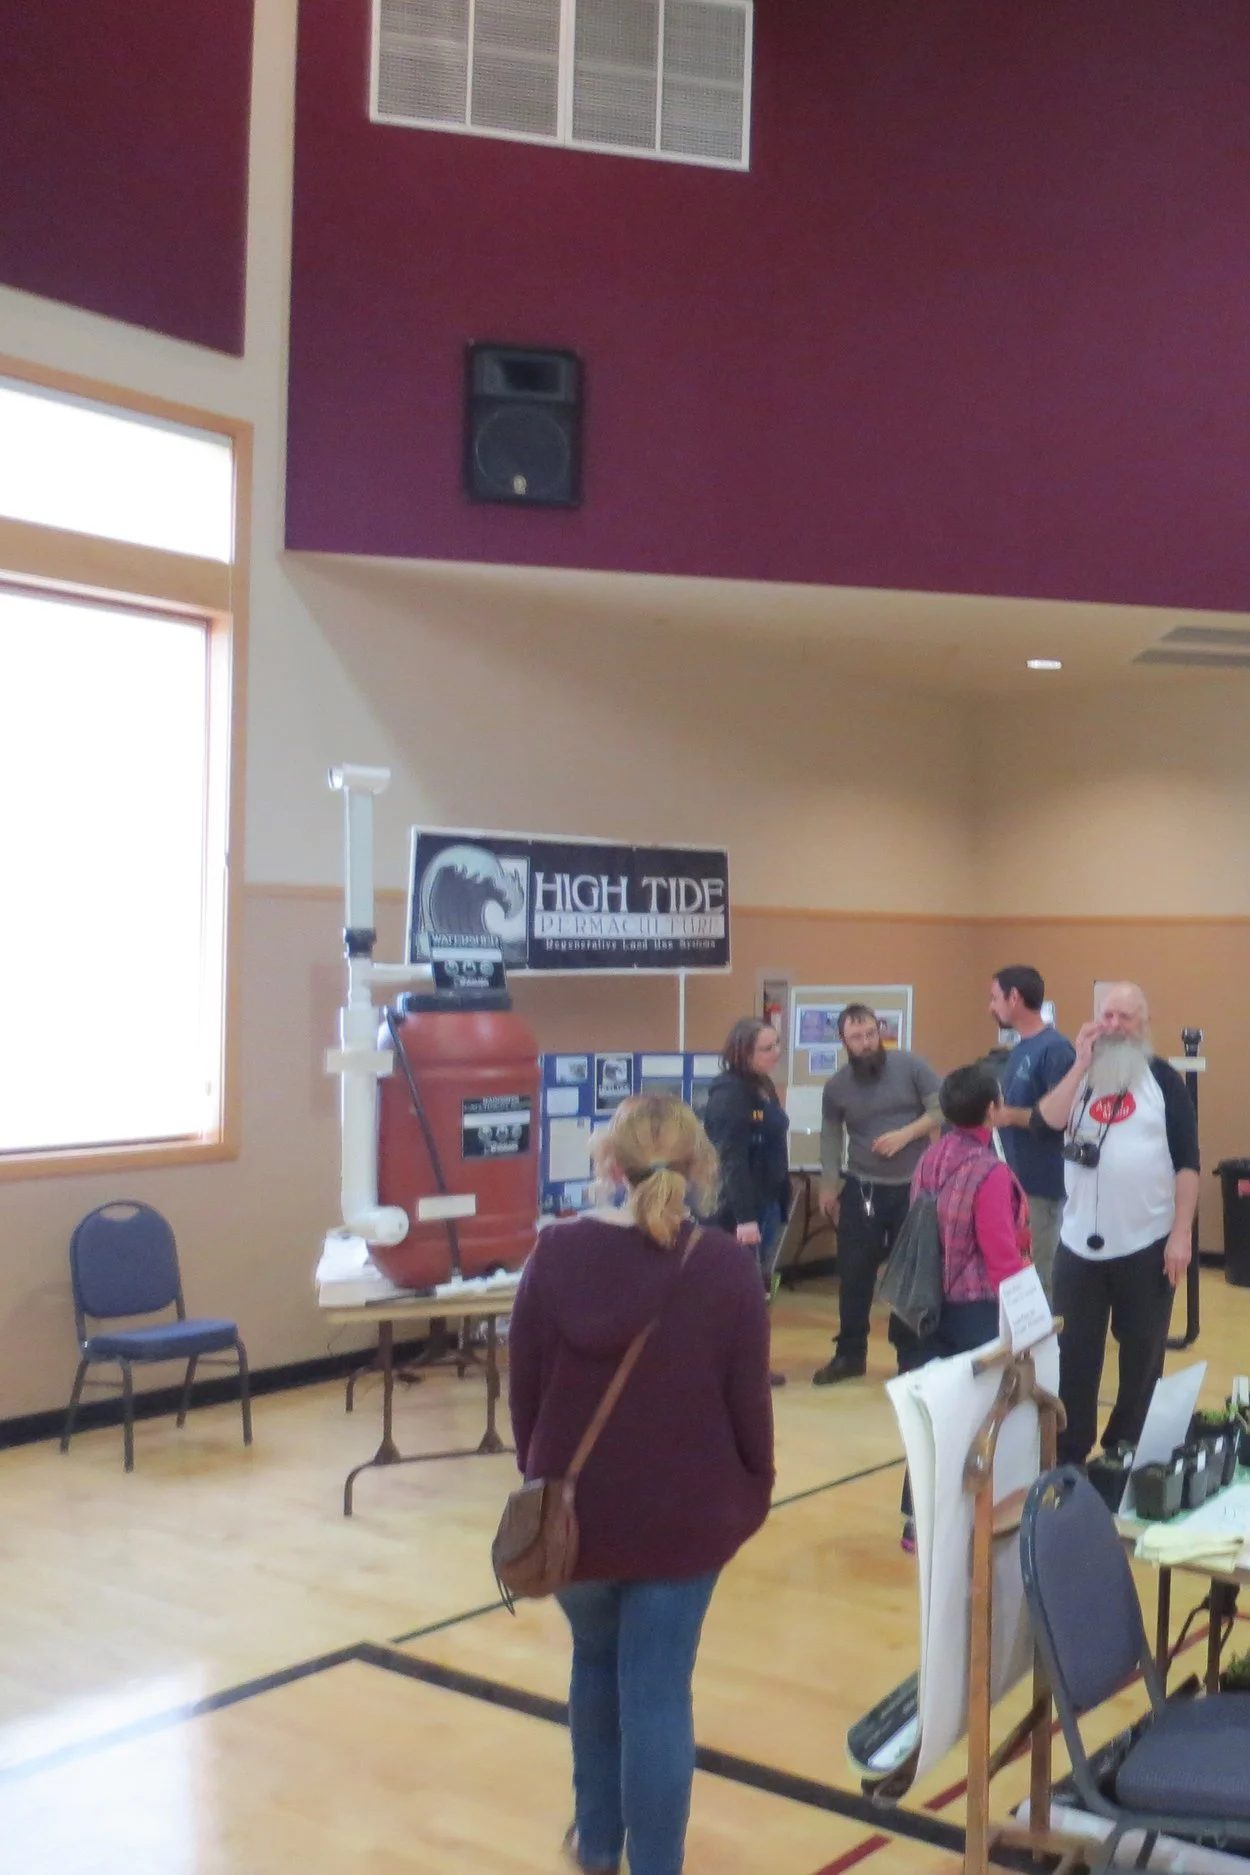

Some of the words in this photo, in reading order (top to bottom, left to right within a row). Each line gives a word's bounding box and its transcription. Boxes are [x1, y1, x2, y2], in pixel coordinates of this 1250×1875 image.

[534, 871, 628, 914] HIGH
[642, 876, 725, 914] TIDE
[540, 914, 721, 935] PERMACULTURE
